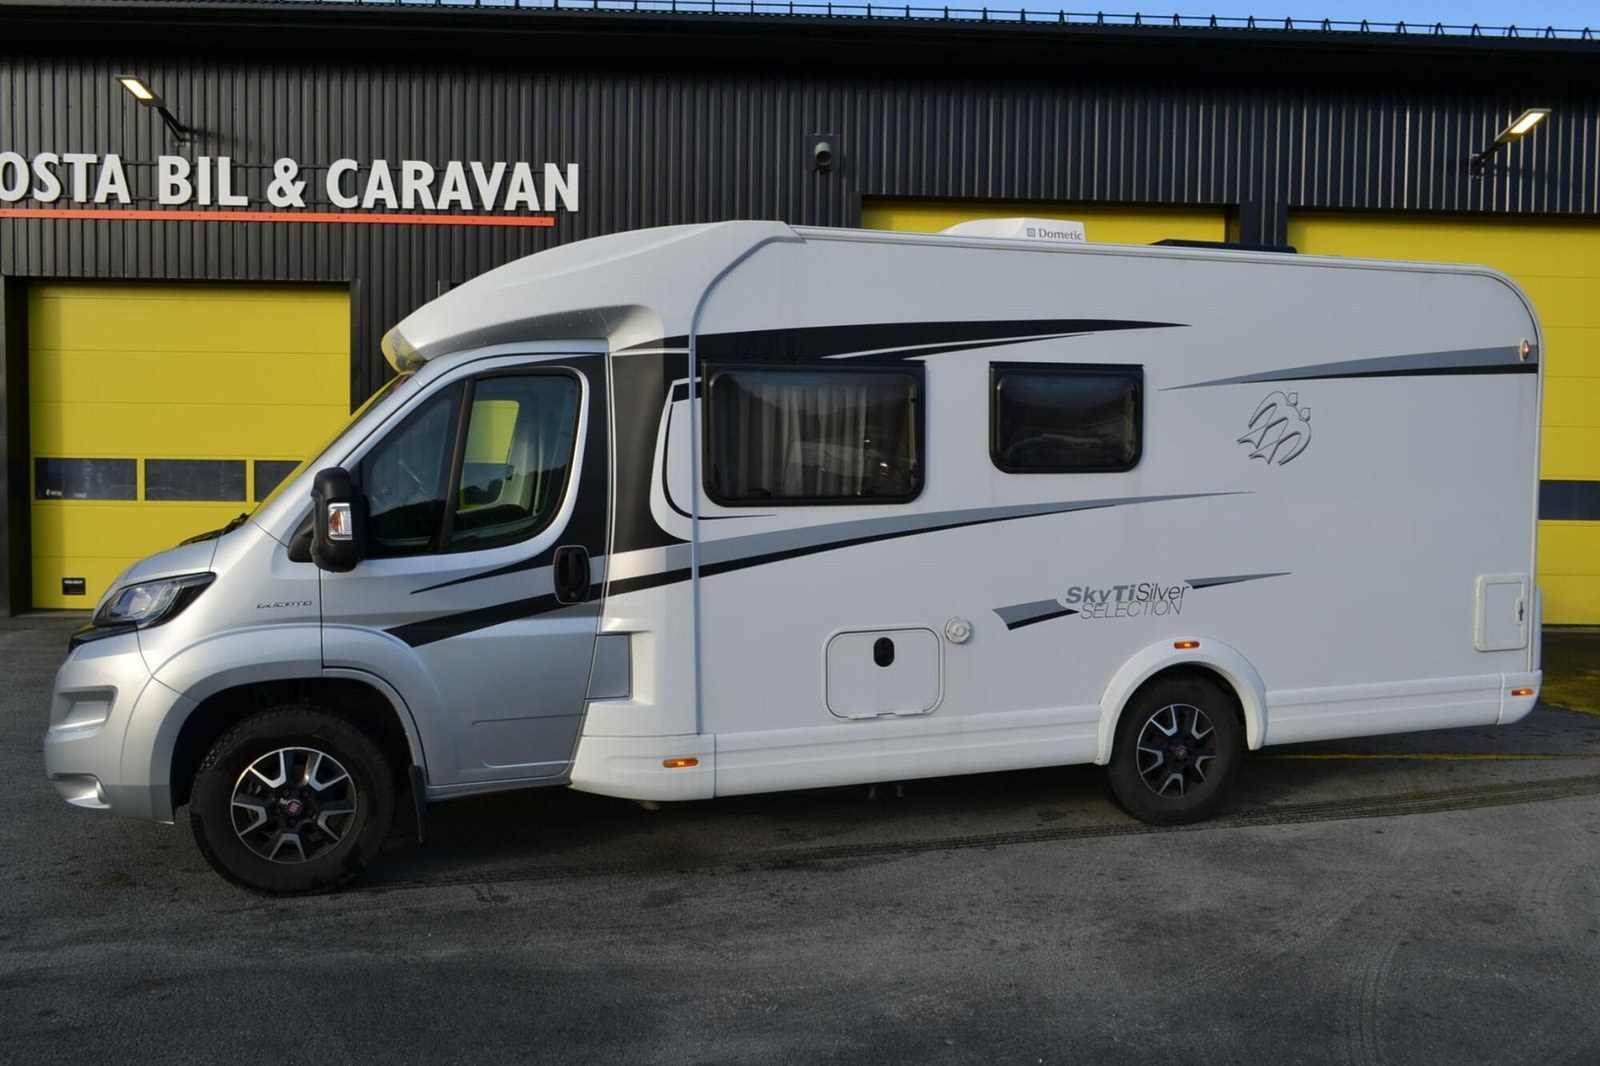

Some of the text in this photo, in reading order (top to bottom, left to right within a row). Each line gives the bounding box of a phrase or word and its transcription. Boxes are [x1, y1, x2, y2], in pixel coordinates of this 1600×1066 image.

[0, 151, 580, 212] OSTA BIL & CARAVAN
[1038, 228, 1083, 240] Dometic
[1080, 600, 1183, 619] SELECTION
